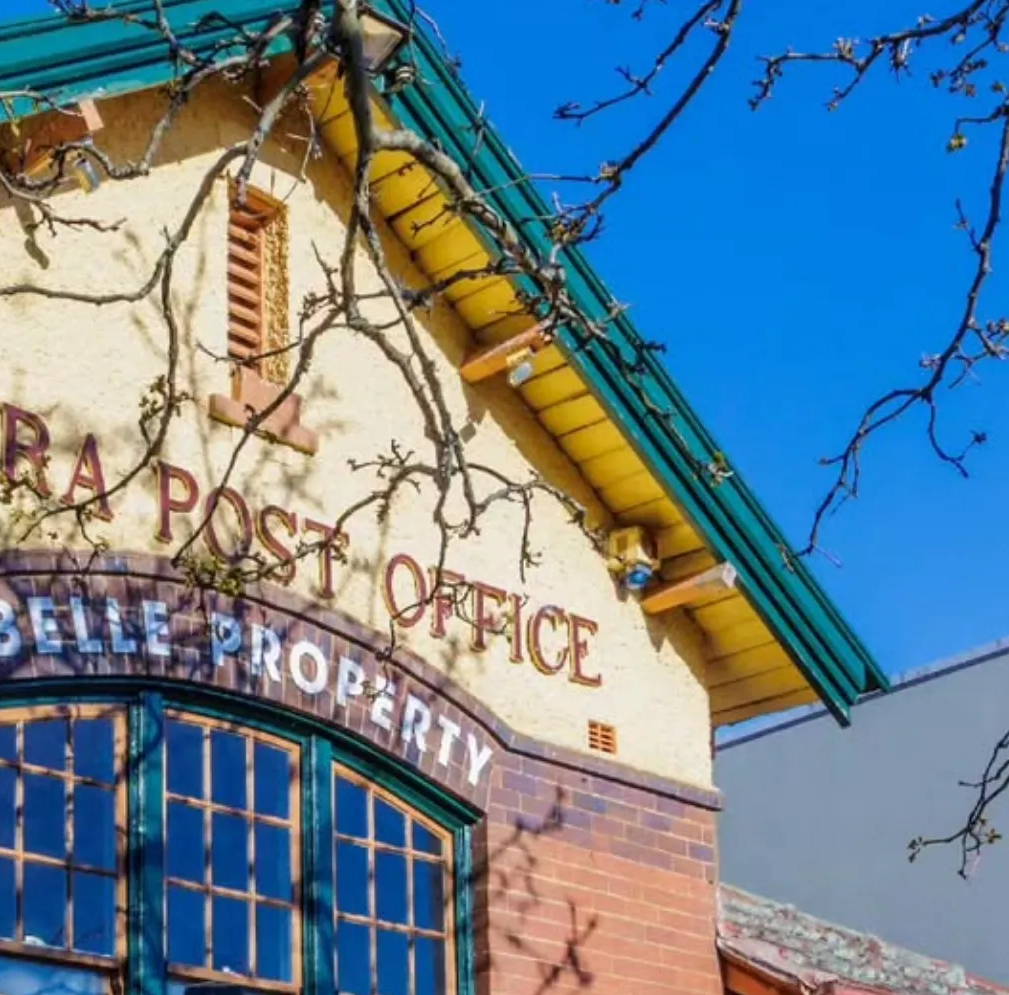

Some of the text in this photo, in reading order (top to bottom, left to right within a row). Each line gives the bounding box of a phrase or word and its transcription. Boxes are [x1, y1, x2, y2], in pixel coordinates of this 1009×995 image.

[153, 461, 350, 599] POST
[384, 553, 603, 688] OFFICE
[210, 611, 493, 786] PROPERTY
